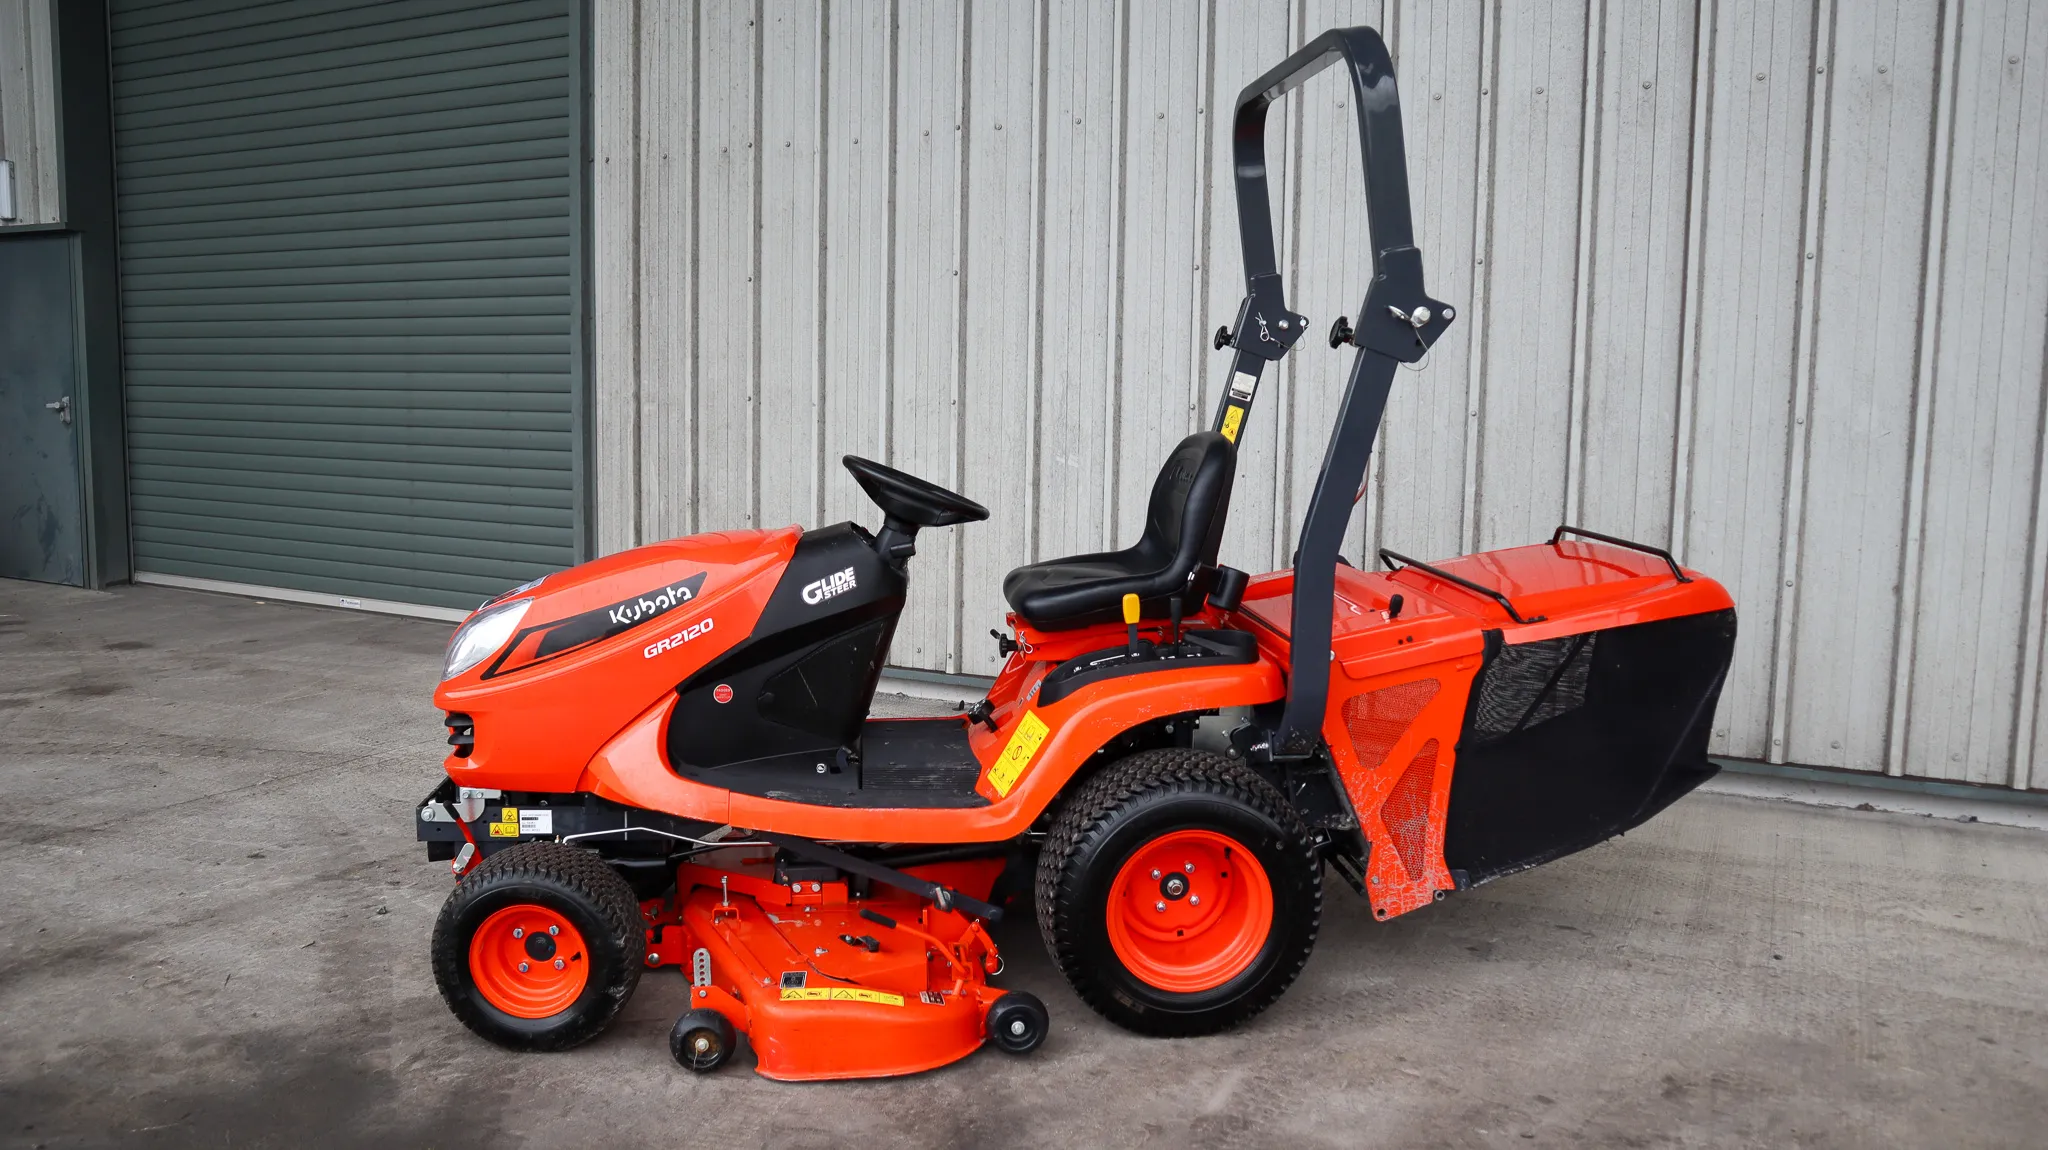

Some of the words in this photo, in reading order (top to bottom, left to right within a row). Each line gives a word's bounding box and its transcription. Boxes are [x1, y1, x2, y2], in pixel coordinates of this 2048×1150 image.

[802, 566, 856, 605] GLIDE
[823, 579, 857, 600] STEER
[608, 586, 692, 625] Kubota
[643, 617, 715, 659] GR2120
